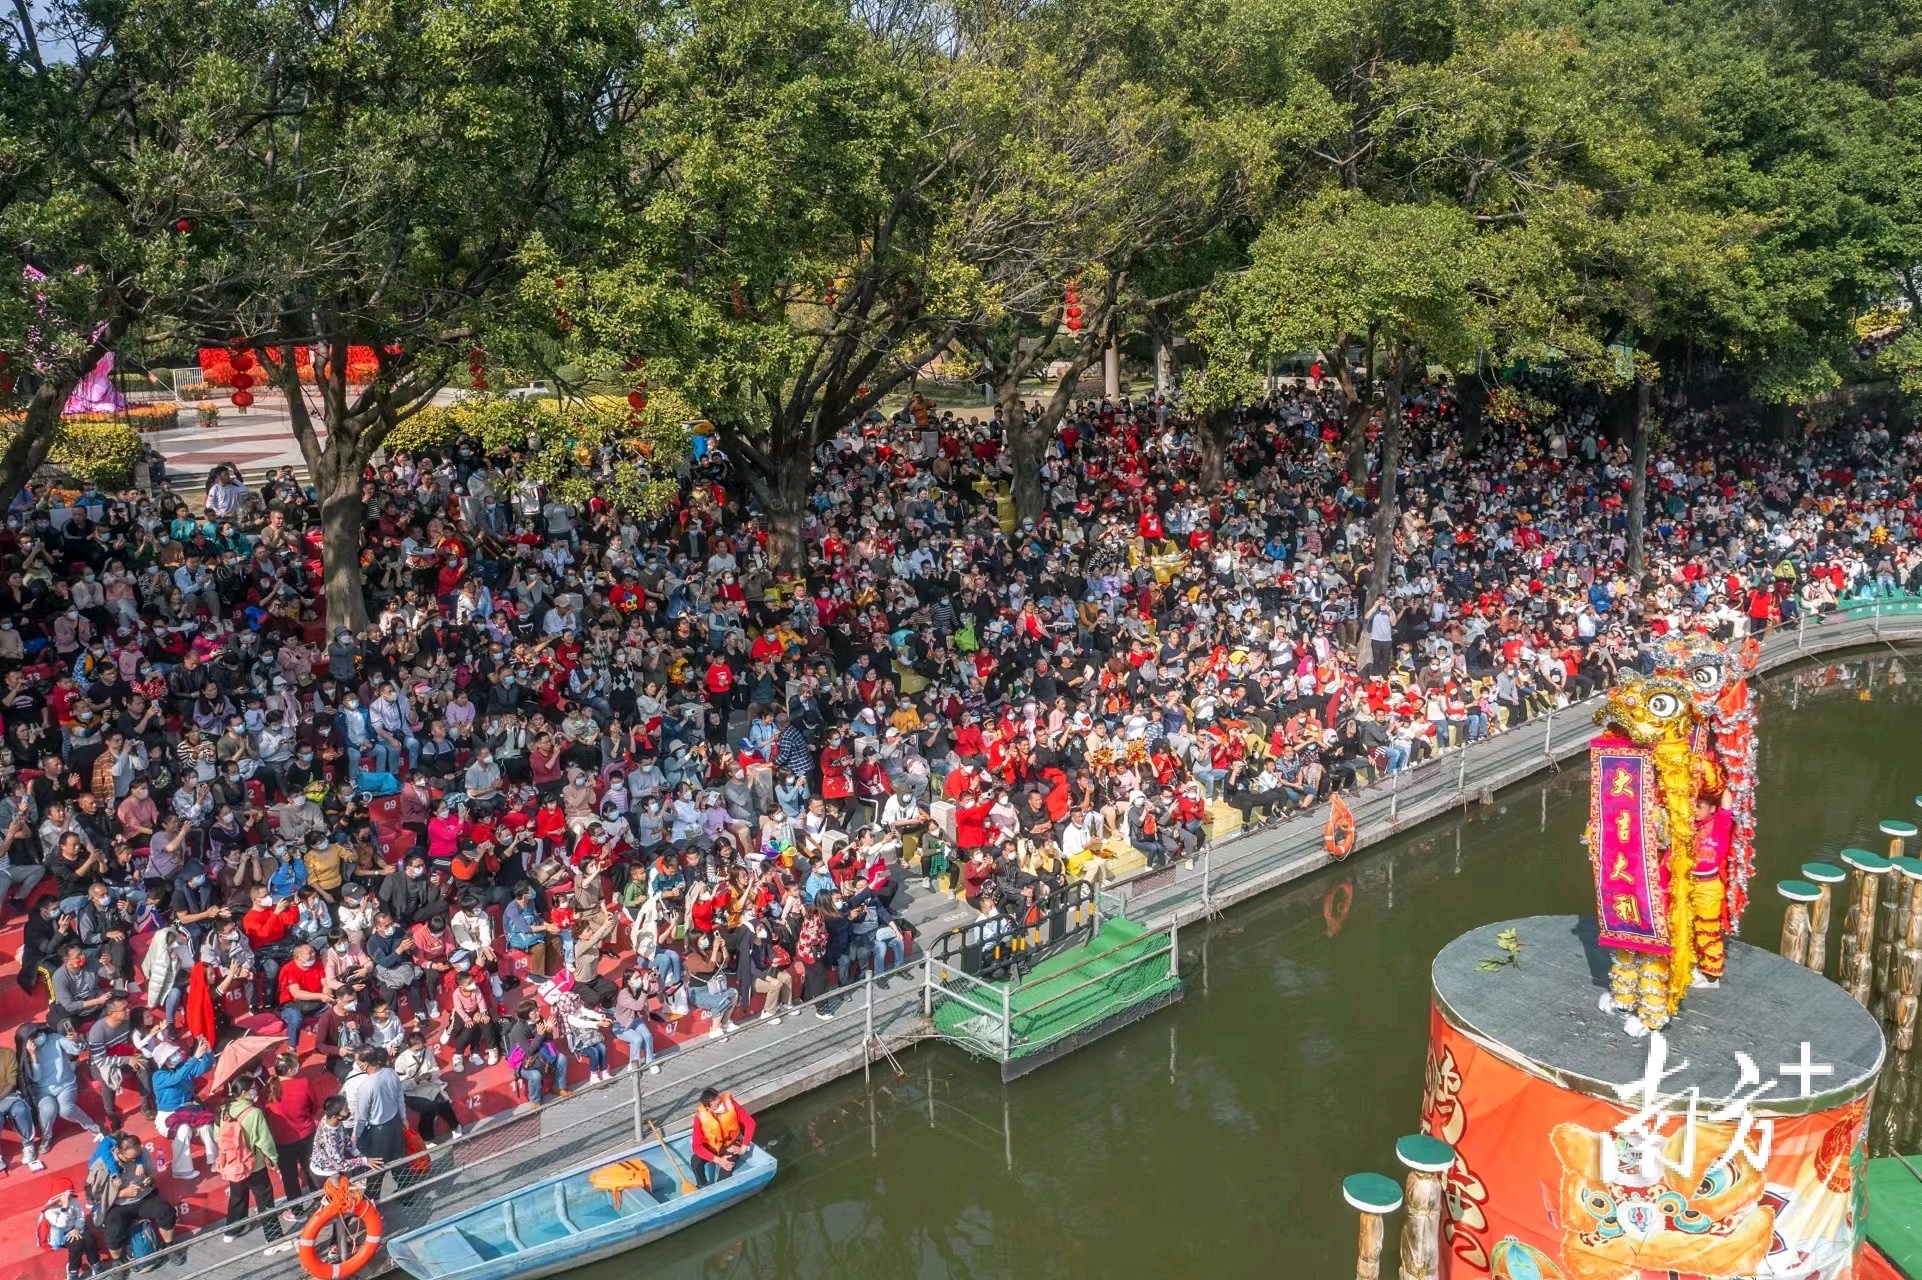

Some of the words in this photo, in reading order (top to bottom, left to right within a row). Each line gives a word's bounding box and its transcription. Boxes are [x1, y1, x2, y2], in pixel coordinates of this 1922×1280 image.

[383, 799, 398, 811] 09
[1609, 768, 1641, 926] 大吉大利
[514, 957, 529, 970] 09
[225, 988, 242, 1002] 15
[665, 1020, 678, 1034] 07
[466, 1094, 482, 1109] 12
